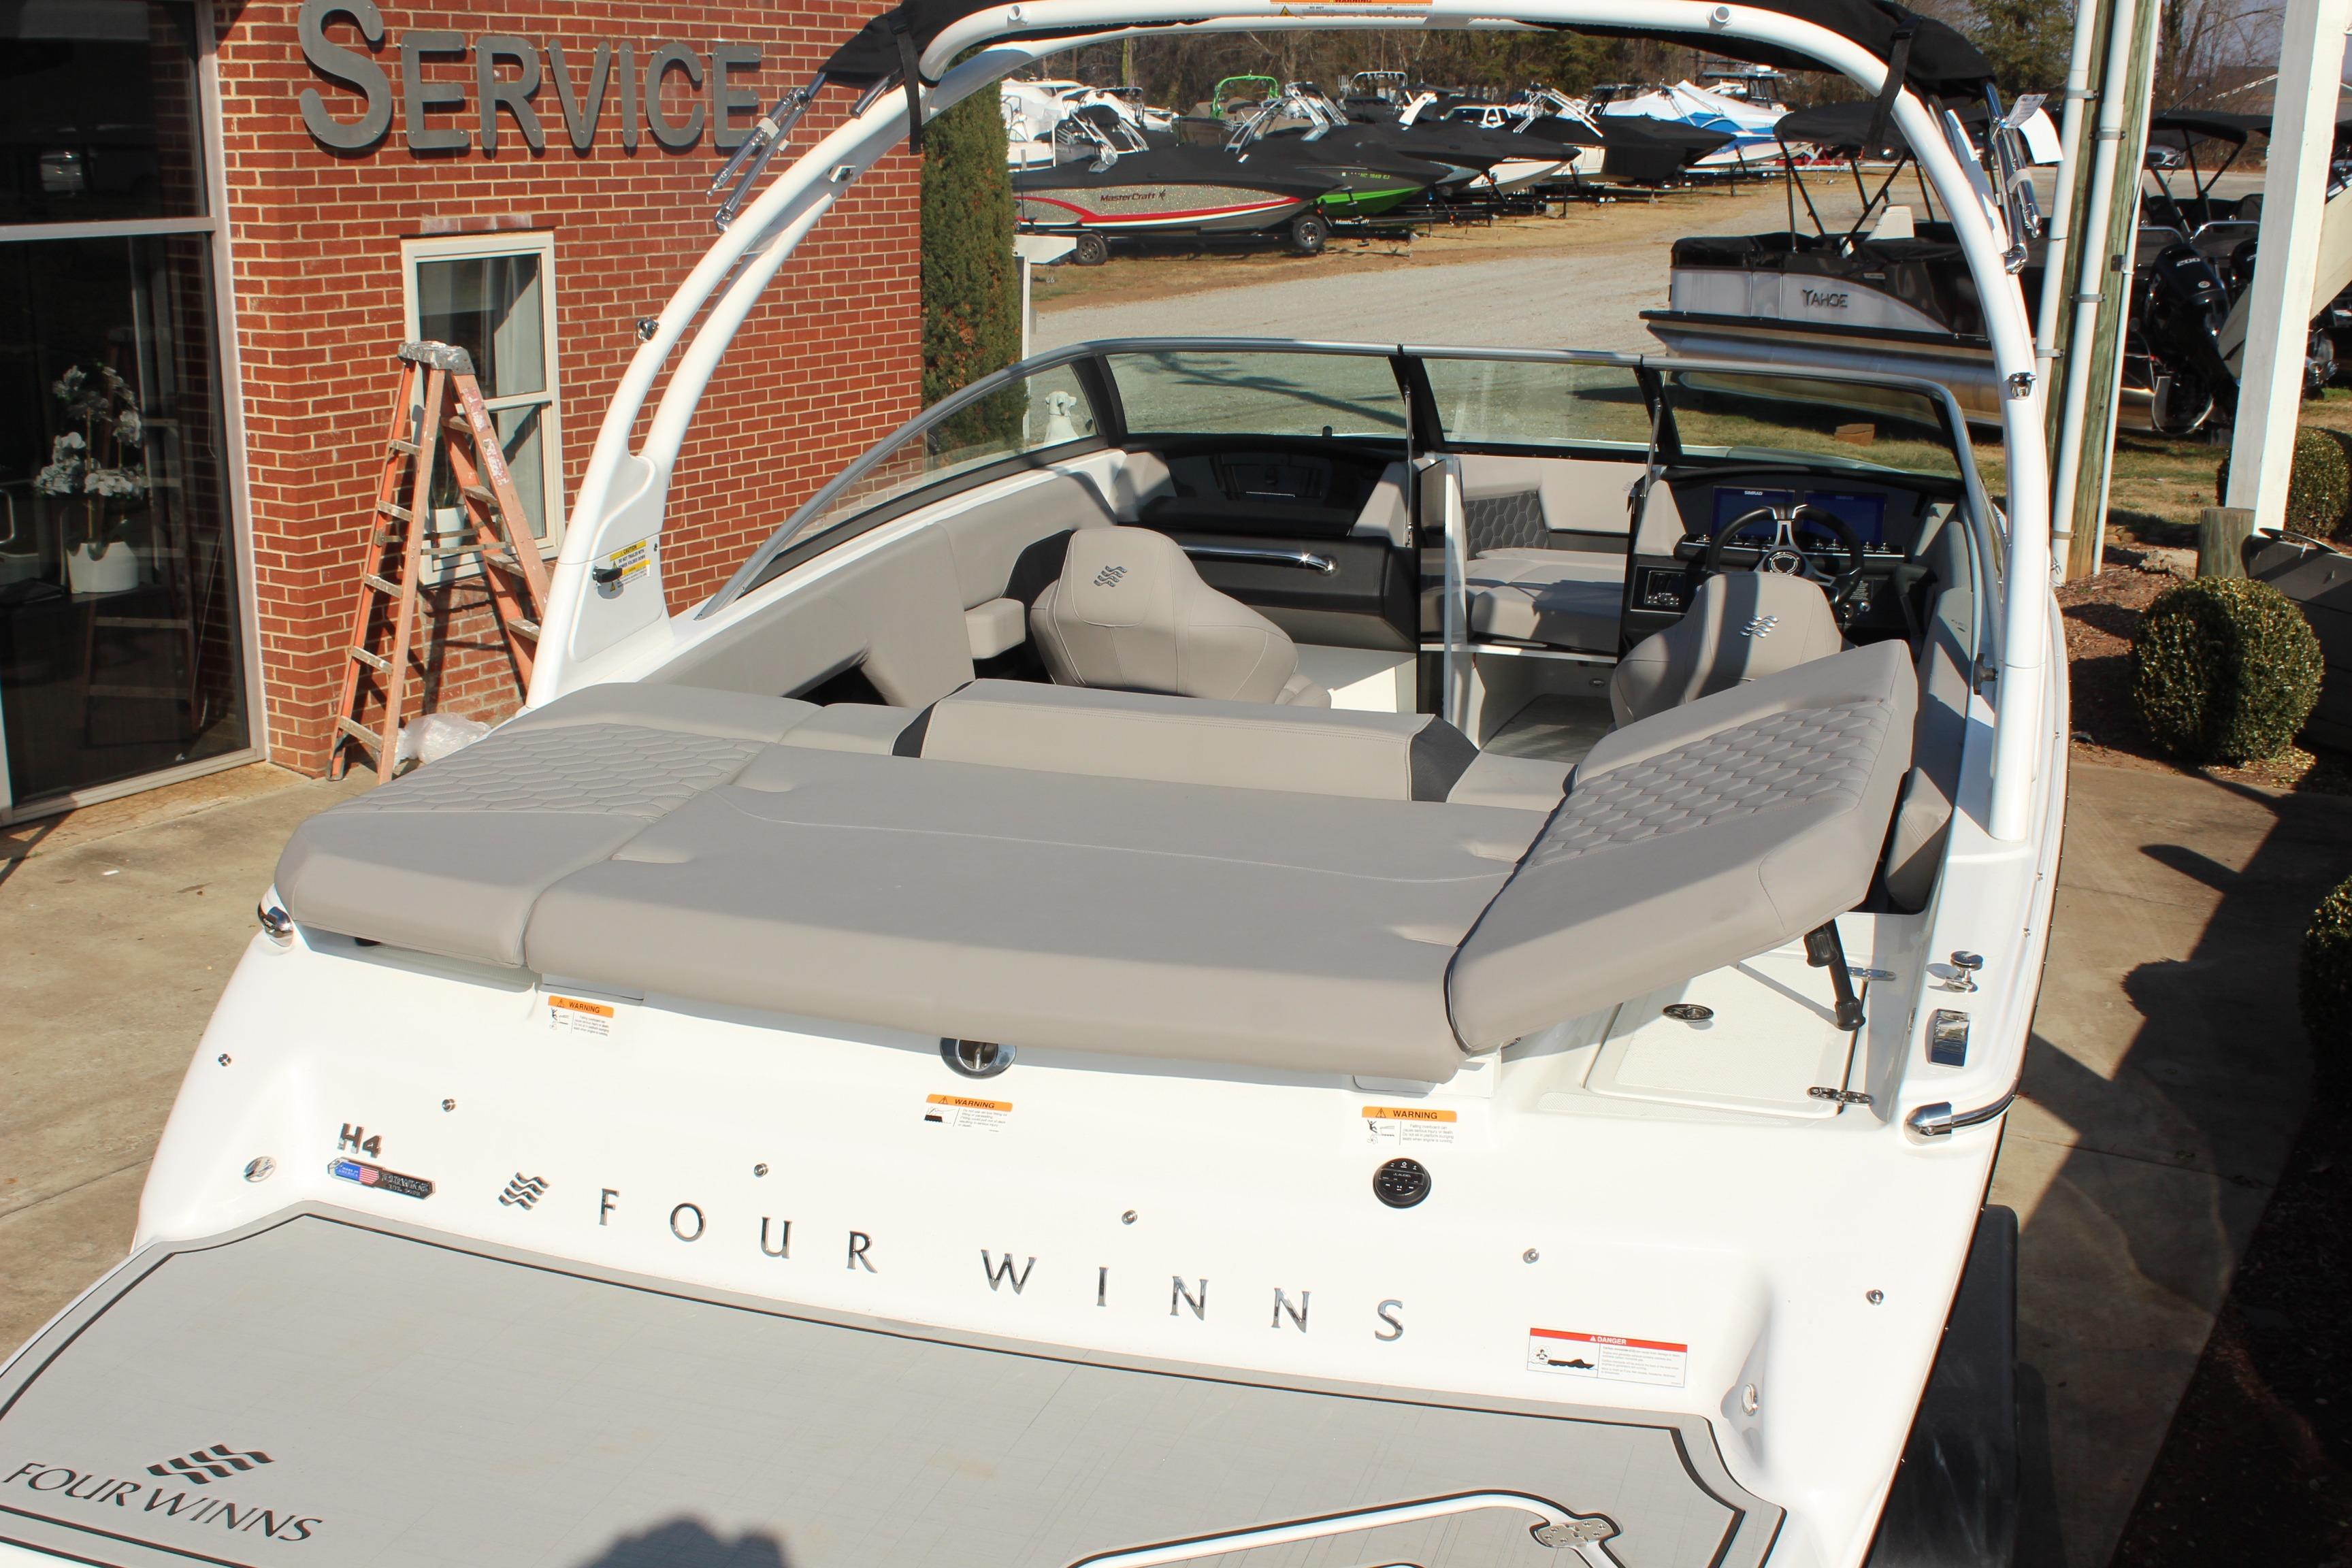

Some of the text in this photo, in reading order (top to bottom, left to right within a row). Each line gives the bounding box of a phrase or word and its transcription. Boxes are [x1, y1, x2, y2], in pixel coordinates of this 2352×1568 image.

[297, 0, 764, 150] SERVICE
[1100, 193, 1156, 201] MasterCraft
[2176, 258, 2201, 267] 200
[1802, 289, 1848, 308] TAHOE
[569, 1001, 600, 1013] WARNING
[954, 1098, 995, 1109] WARNING
[1393, 1109, 1438, 1120] WARNING
[338, 1123, 382, 1158] H4
[599, 1188, 1404, 1341] FOUR WINNS
[1597, 1335, 1627, 1345] DANGER
[2, 1463, 323, 1541] FOUR WINNS
